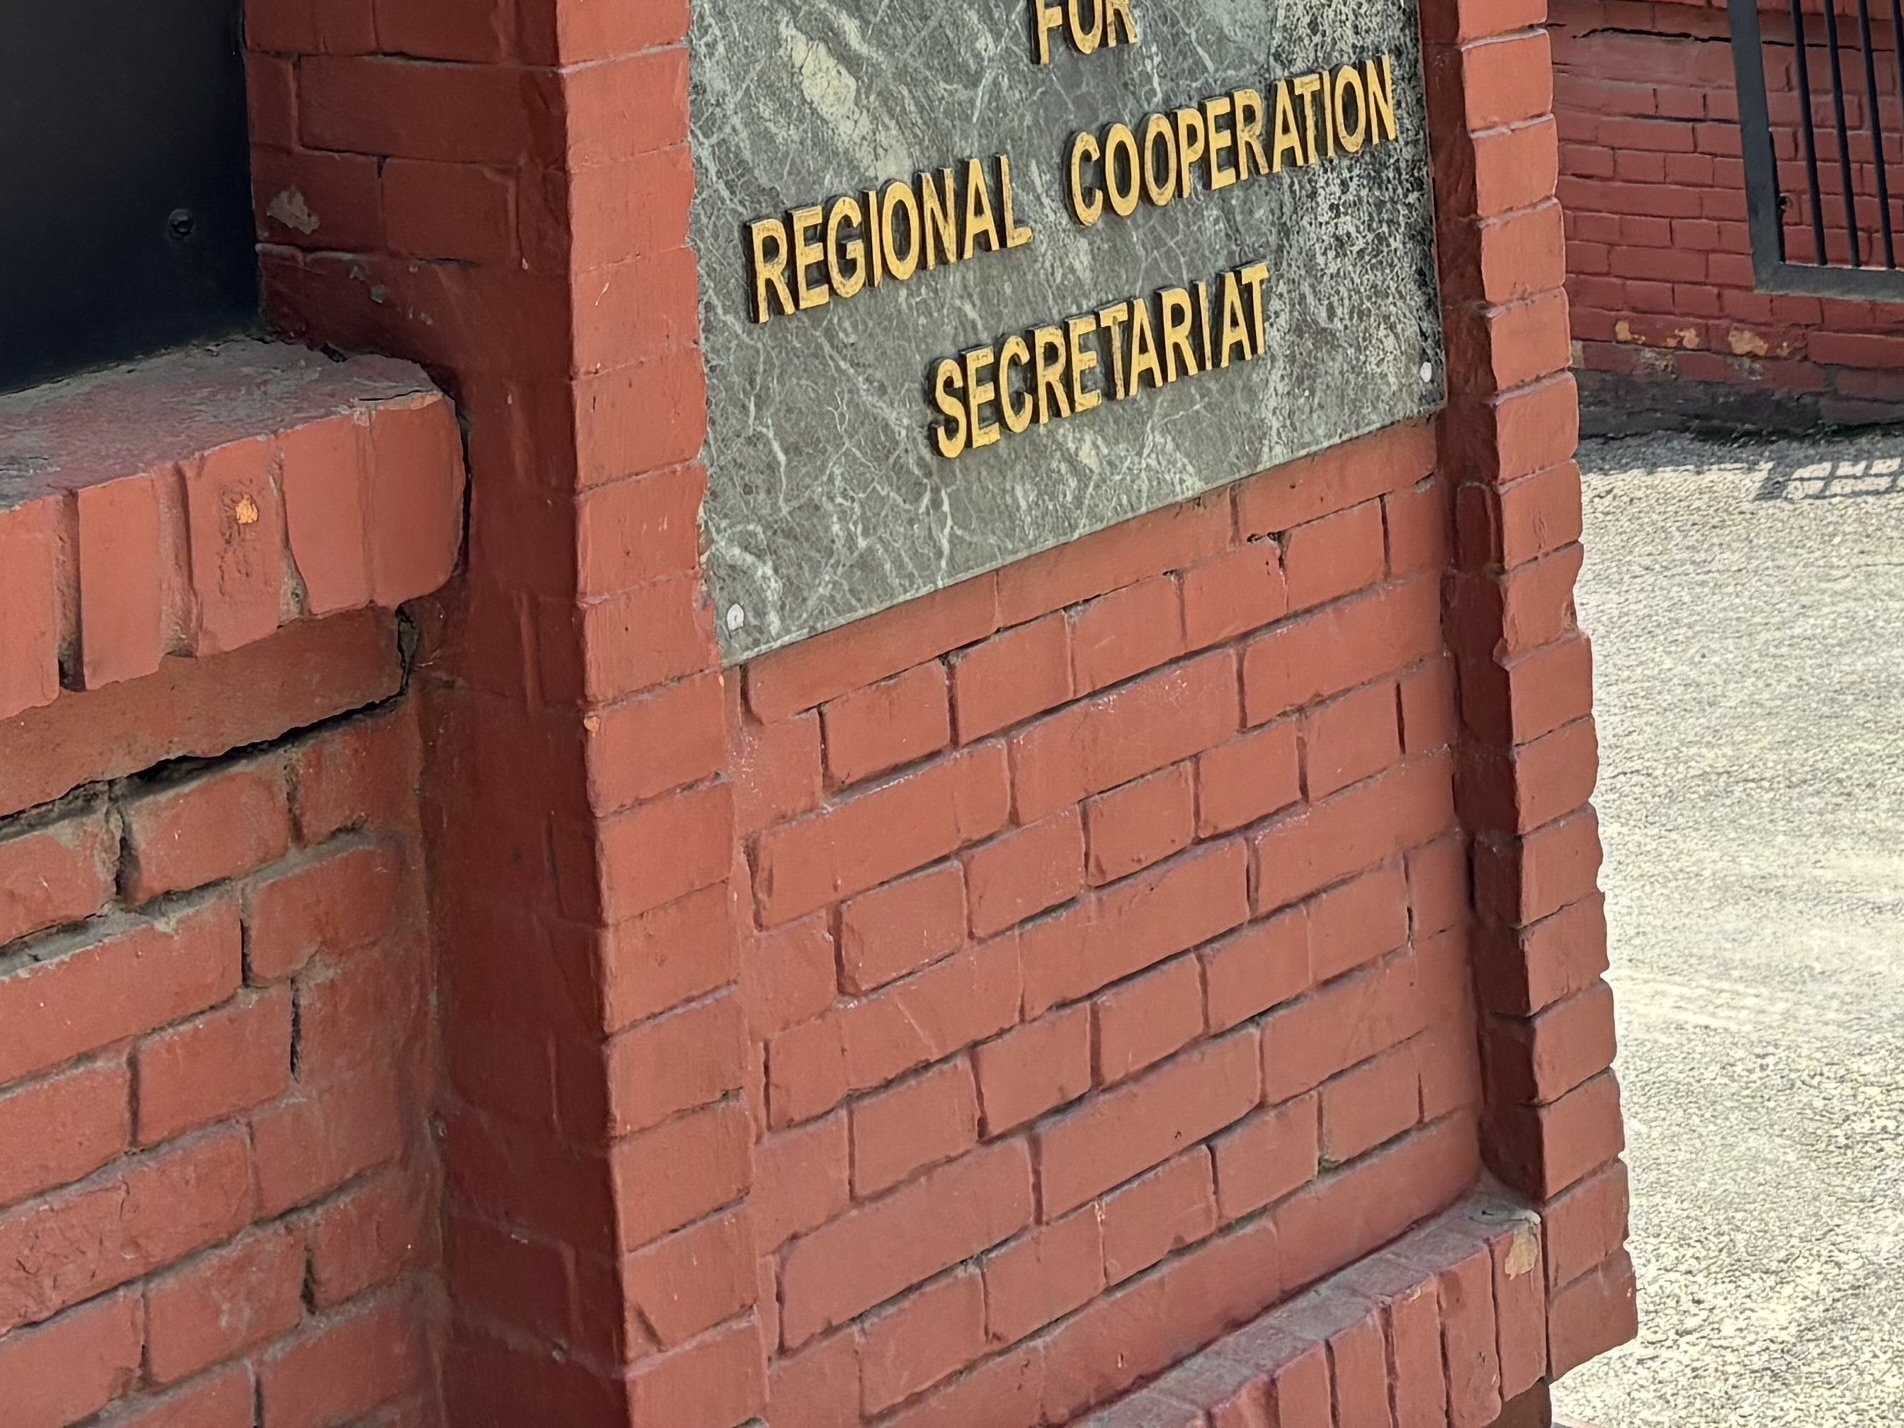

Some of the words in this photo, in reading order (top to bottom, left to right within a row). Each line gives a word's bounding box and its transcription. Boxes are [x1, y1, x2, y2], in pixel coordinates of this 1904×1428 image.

[745, 153, 1033, 324] REGIONAL
[1066, 53, 1398, 227] COOPERATION
[928, 260, 1271, 459] SECRETARIAT
